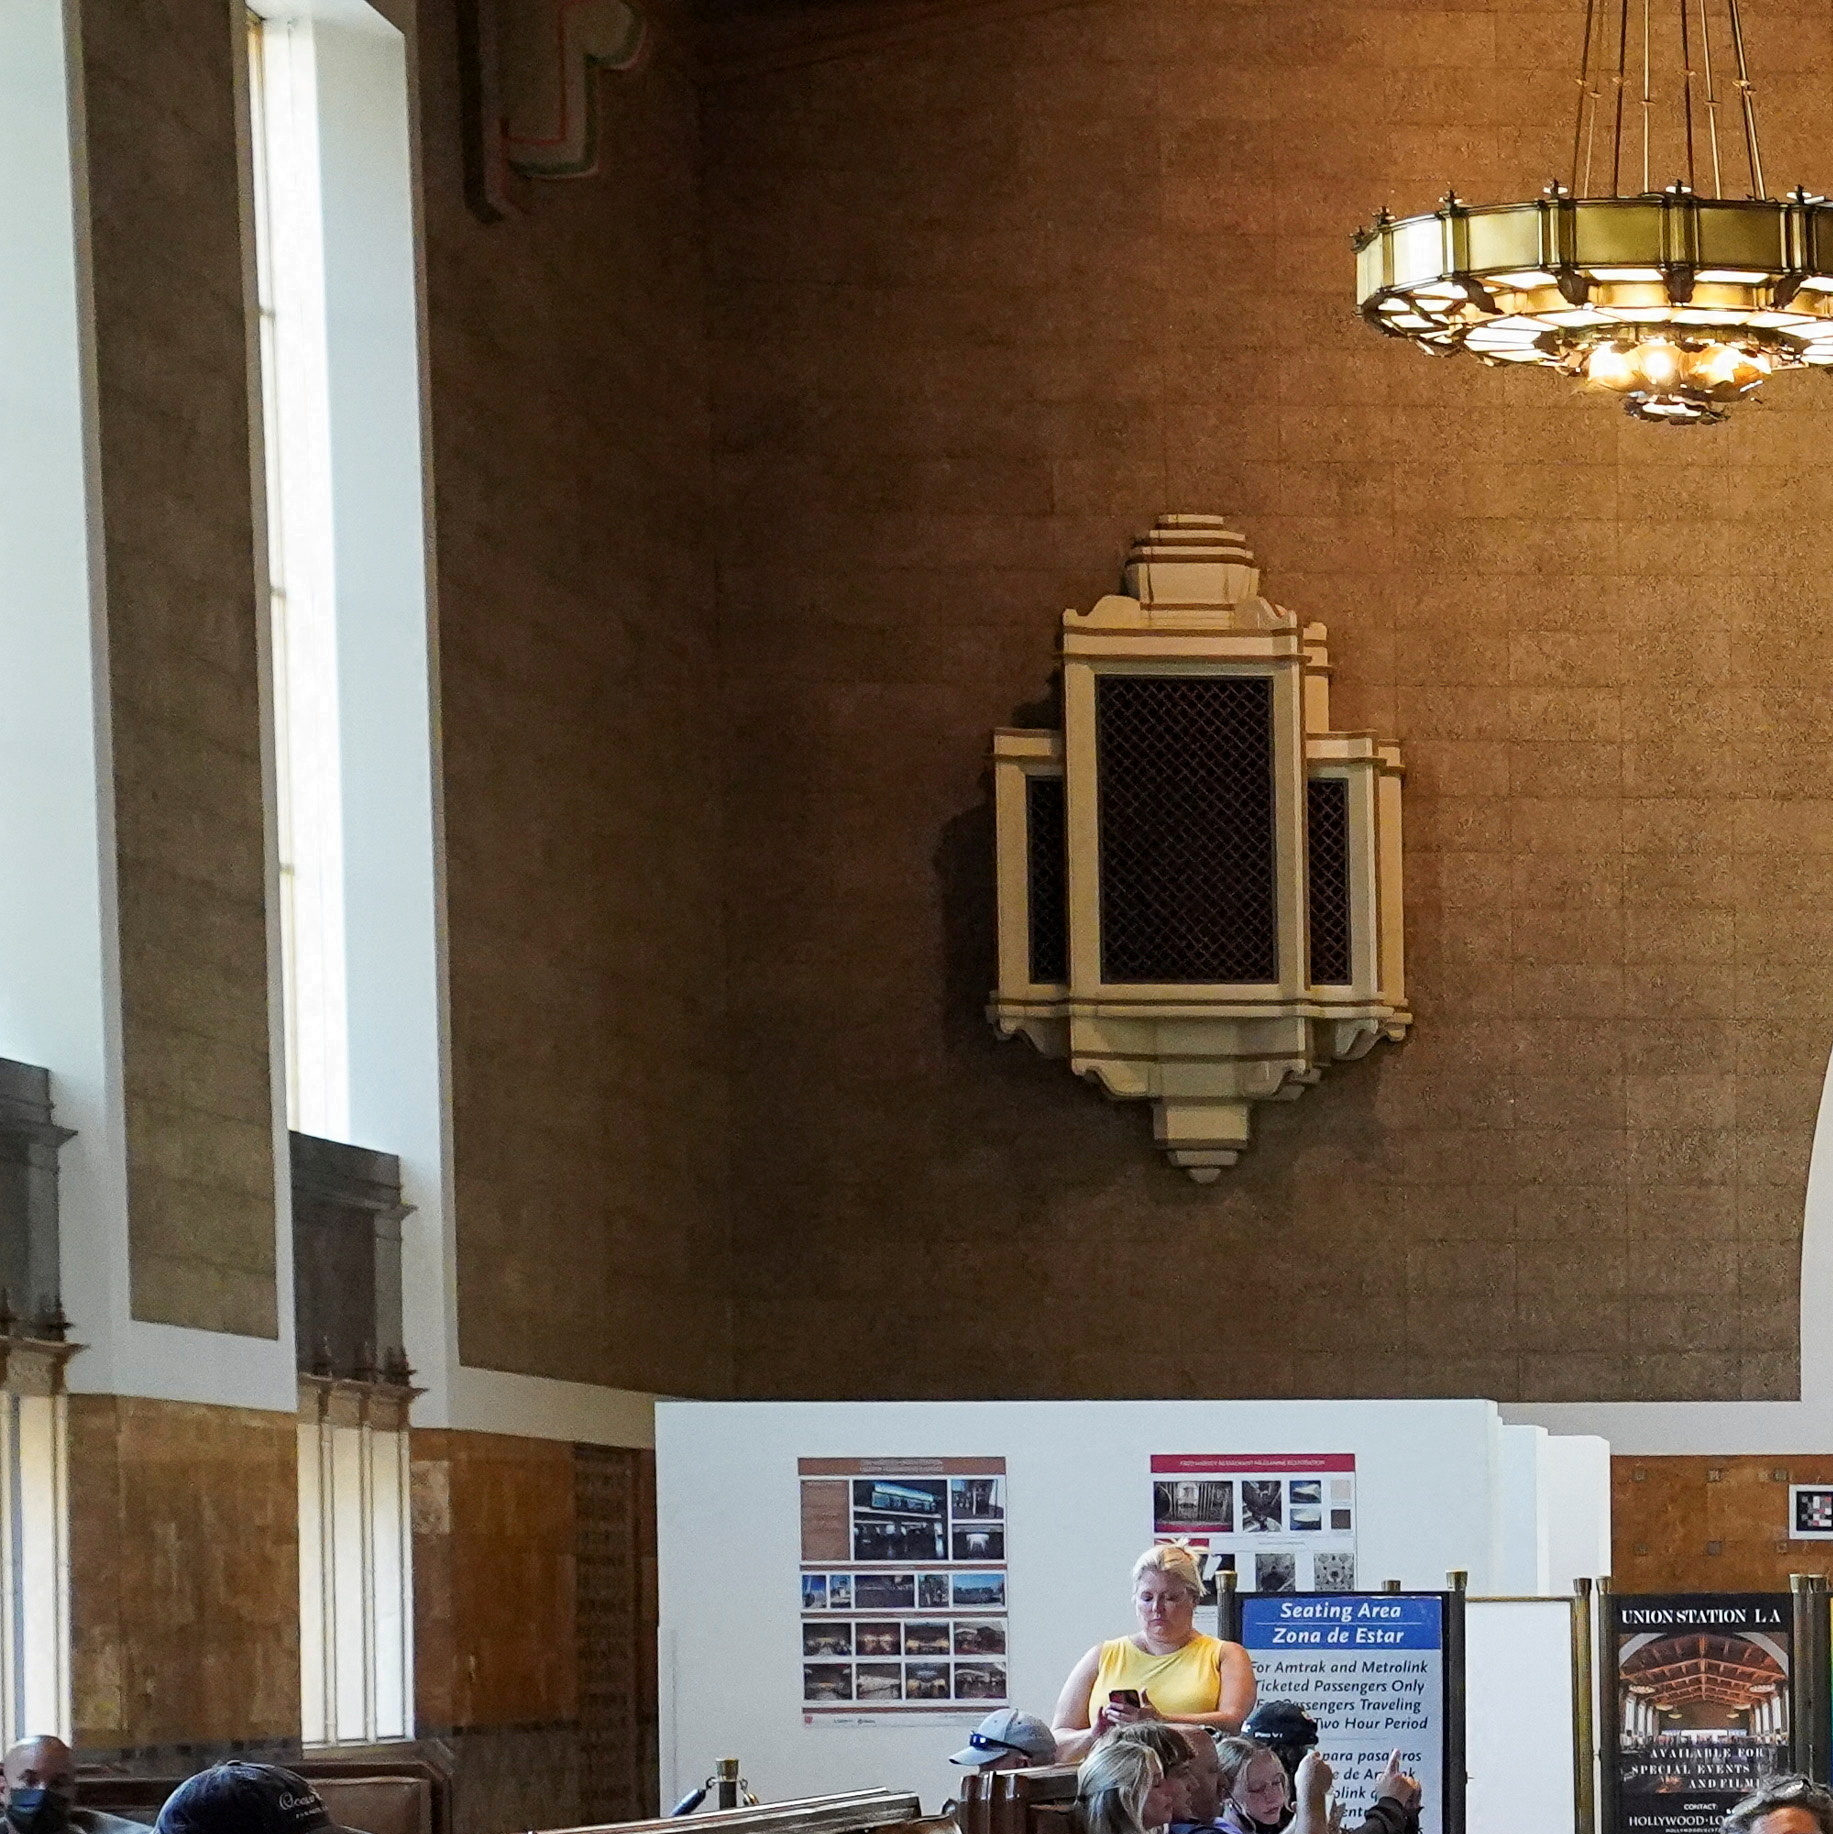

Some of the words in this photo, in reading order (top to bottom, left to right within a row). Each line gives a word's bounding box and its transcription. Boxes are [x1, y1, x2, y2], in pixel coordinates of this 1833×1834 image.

[1280, 1603, 1353, 1622] Seating
[1357, 1603, 1401, 1618] Area
[1621, 1609, 1674, 1624] UNION
[1676, 1608, 1747, 1624] STATION
[1272, 1628, 1321, 1643] Zona
[1327, 1627, 1349, 1643] de
[1356, 1628, 1405, 1643] Estar
[1274, 1660, 1326, 1673] Amtrak
[1330, 1660, 1357, 1673] and
[1361, 1660, 1429, 1673] Metrolink
[1256, 1679, 1310, 1692] Ticketed
[1314, 1680, 1387, 1695] Passengers
[1391, 1680, 1425, 1695] Only
[1360, 1698, 1421, 1714] Traveling
[1314, 1717, 1340, 1729] Two
[1344, 1717, 1380, 1729] Hour
[1384, 1717, 1428, 1729] Period
[1357, 1751, 1422, 1765] pasaros
[1650, 1748, 1731, 1759] AVAILABLE
[1738, 1748, 1764, 1757] FOR
[1343, 1767, 1360, 1780] de
[1631, 1764, 1691, 1775] SPECIAL
[1697, 1763, 1750, 1774] EVENTS
[1688, 1779, 1717, 1789] AND
[1720, 1778, 1760, 1789] FILMI
